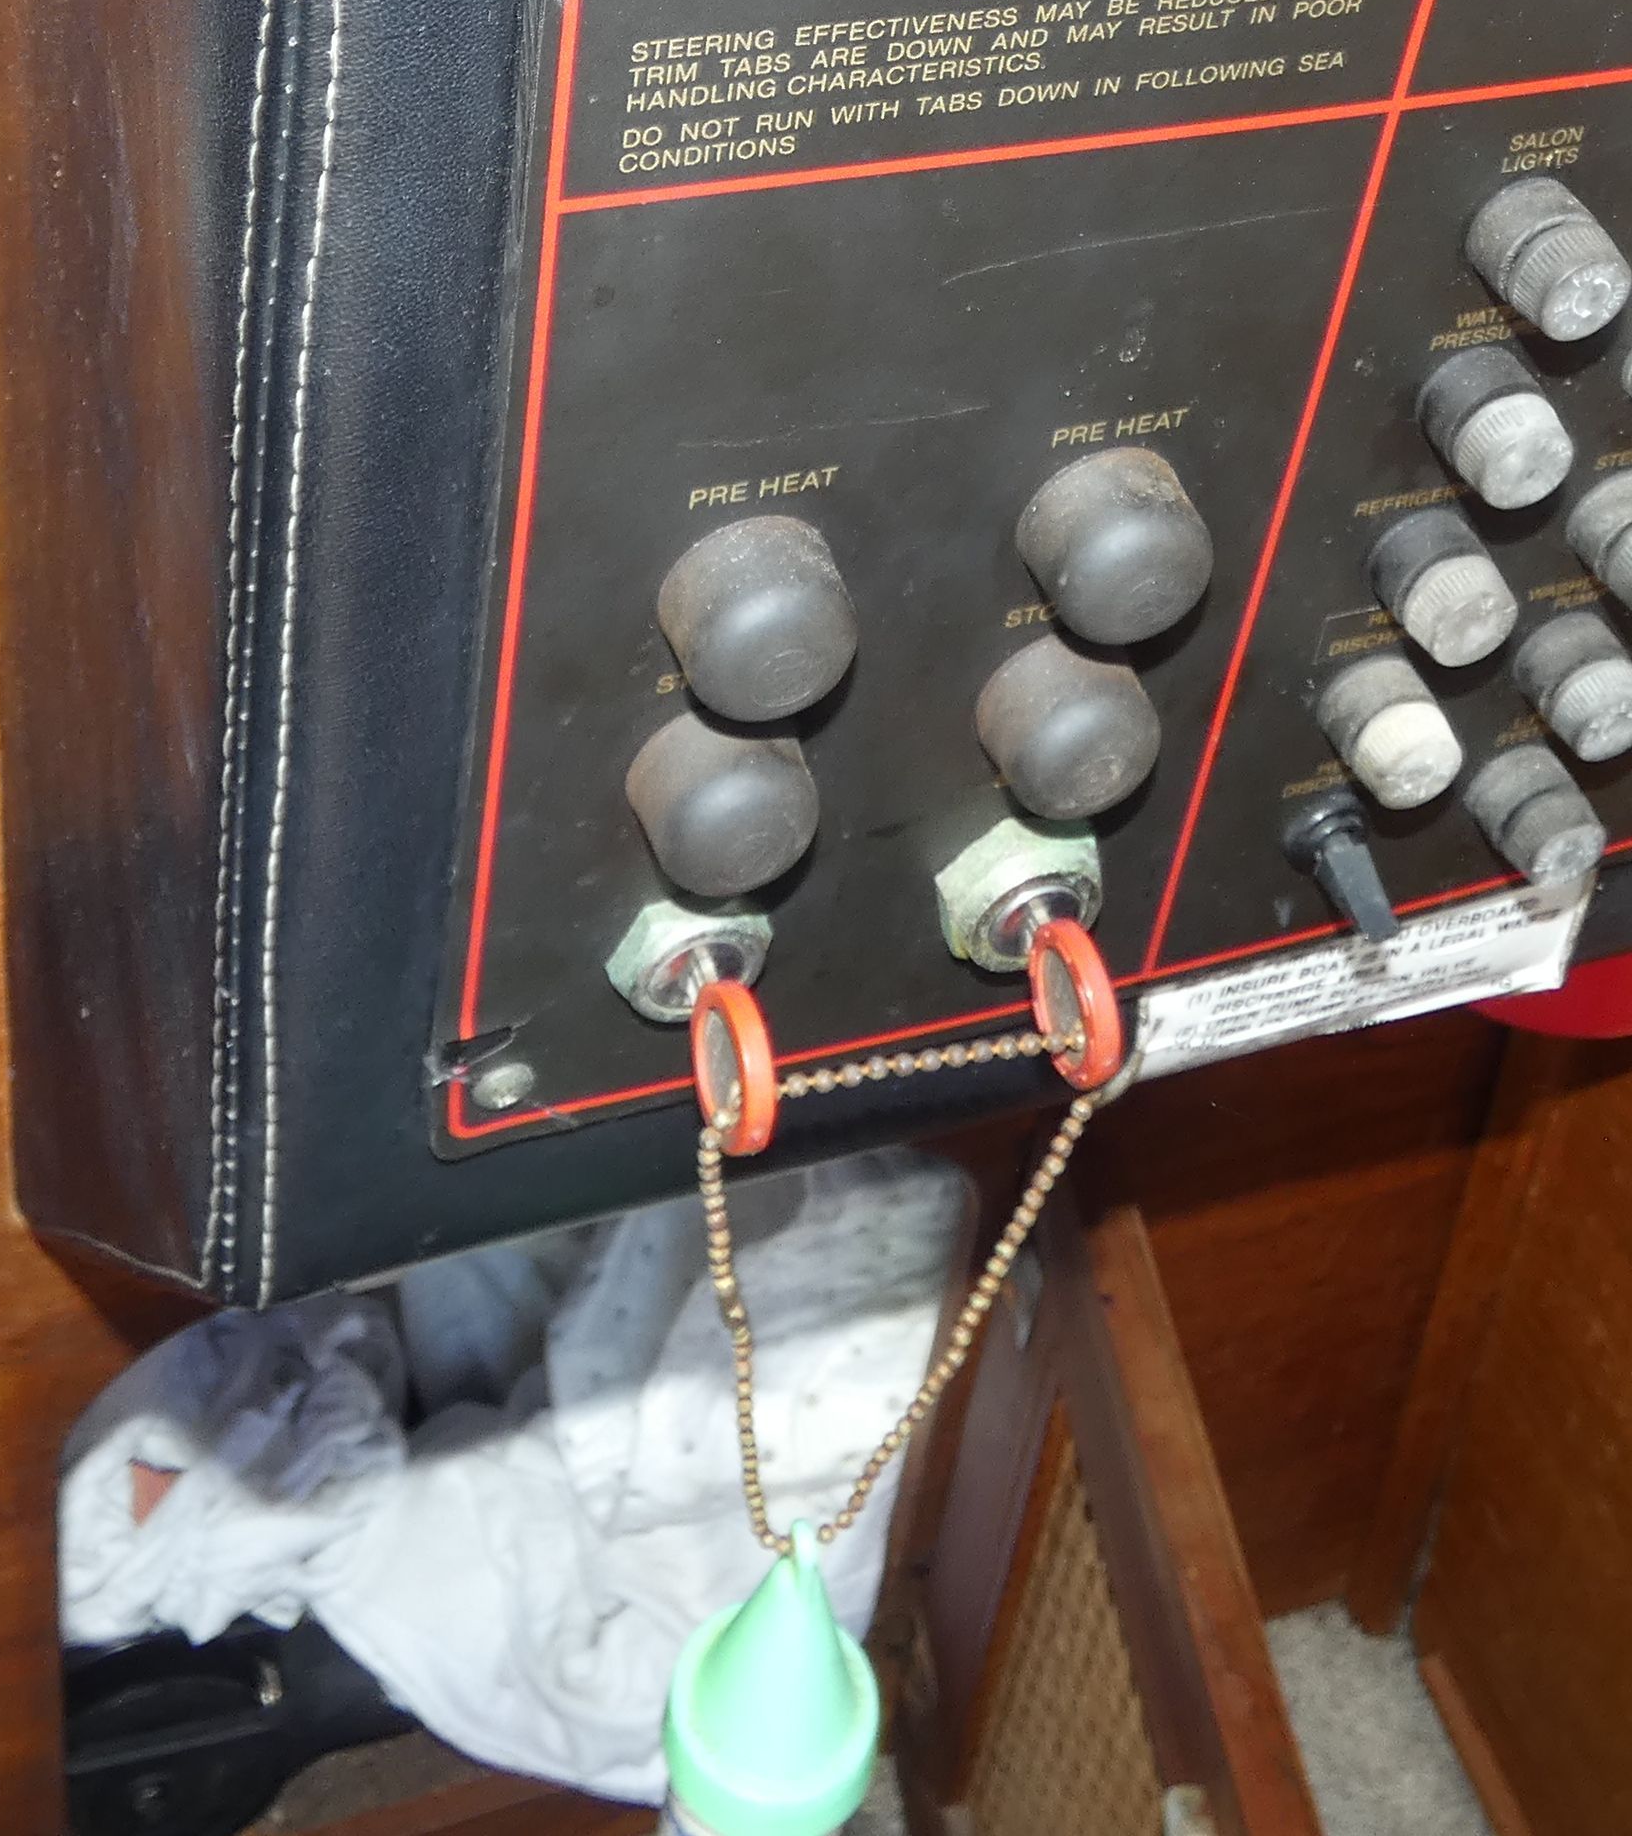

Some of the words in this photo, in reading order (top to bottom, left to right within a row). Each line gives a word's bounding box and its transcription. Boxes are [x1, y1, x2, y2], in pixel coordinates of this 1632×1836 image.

[629, 62, 698, 88] TRIM
[720, 53, 791, 79] TABS
[810, 46, 868, 69] ARE
[887, 36, 972, 62] DOWN
[991, 30, 1049, 51] AND
[1067, 21, 1121, 45] MAY
[1138, 9, 1234, 37] RESULT
[1250, 5, 1277, 25] IN
[630, 30, 775, 63] STEERING
[795, 7, 1018, 48] EFFECTIVENESS
[1035, 1, 1091, 24] MAY
[623, 127, 662, 150] DO
[680, 116, 739, 143] NOT
[755, 110, 813, 134] RUN
[831, 99, 900, 126] WITH
[916, 92, 983, 117] TABS
[998, 80, 1080, 107] DOWN
[1094, 76, 1121, 97] IN
[1135, 58, 1285, 93] FOLLOWING
[1298, 51, 1346, 73] SEA
[626, 76, 776, 113] HANDLING
[787, 52, 1046, 96] CHARACTERISTICS.
[618, 135, 796, 174] CONDITIONS
[1509, 126, 1585, 153] SALON
[1501, 148, 1580, 174] LIGHTS
[1457, 307, 1506, 329] WAT
[1429, 325, 1512, 352] PRESSU
[1052, 421, 1107, 448] PRE
[1116, 407, 1190, 439] HEAT
[689, 480, 749, 510] PRE
[759, 466, 840, 499] HEAT
[1354, 486, 1462, 517] REFRIGER
[1003, 604, 1056, 629] STO
